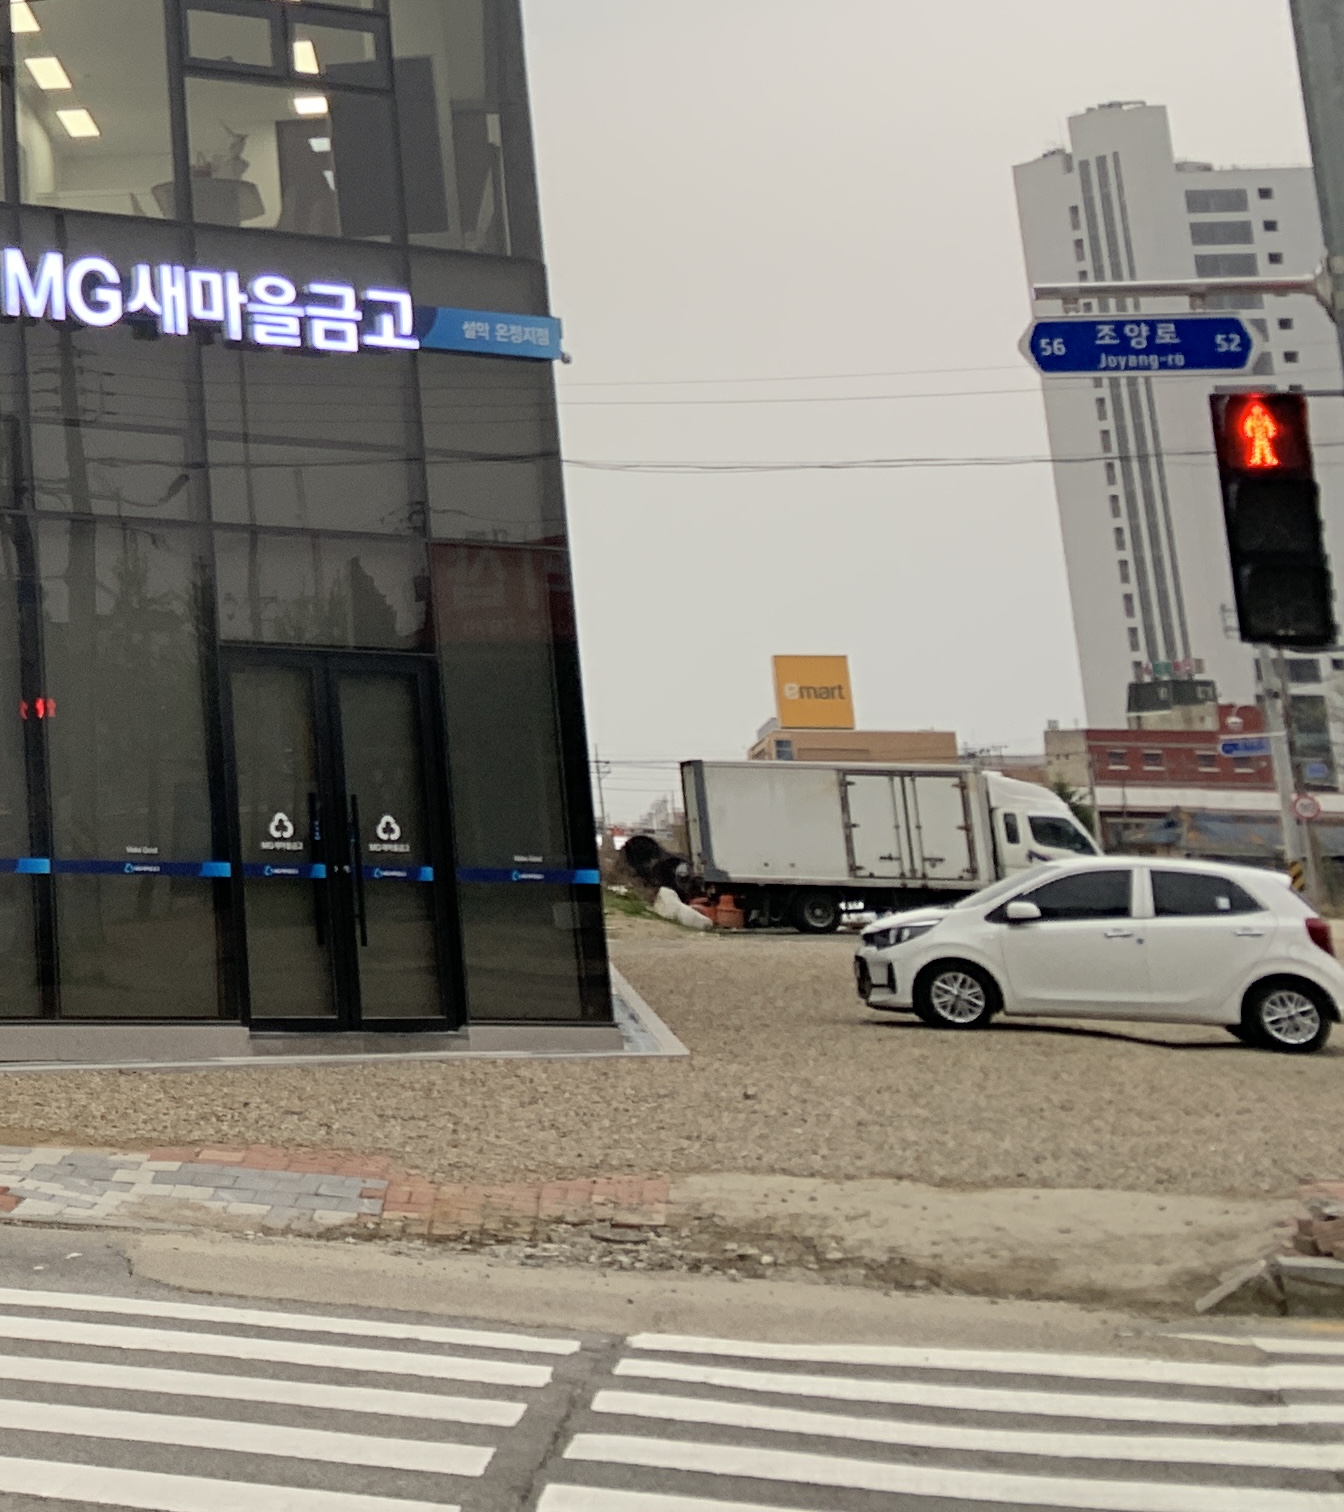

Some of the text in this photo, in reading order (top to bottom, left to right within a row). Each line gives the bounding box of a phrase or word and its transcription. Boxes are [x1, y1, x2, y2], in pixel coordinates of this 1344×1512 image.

[0, 246, 420, 353] MG새마을금고
[1094, 323, 1181, 349] 조양로
[1214, 334, 1243, 353] 52
[1039, 338, 1067, 357] 56
[1098, 352, 1186, 370] Joyang-ro
[783, 682, 846, 701] emart
